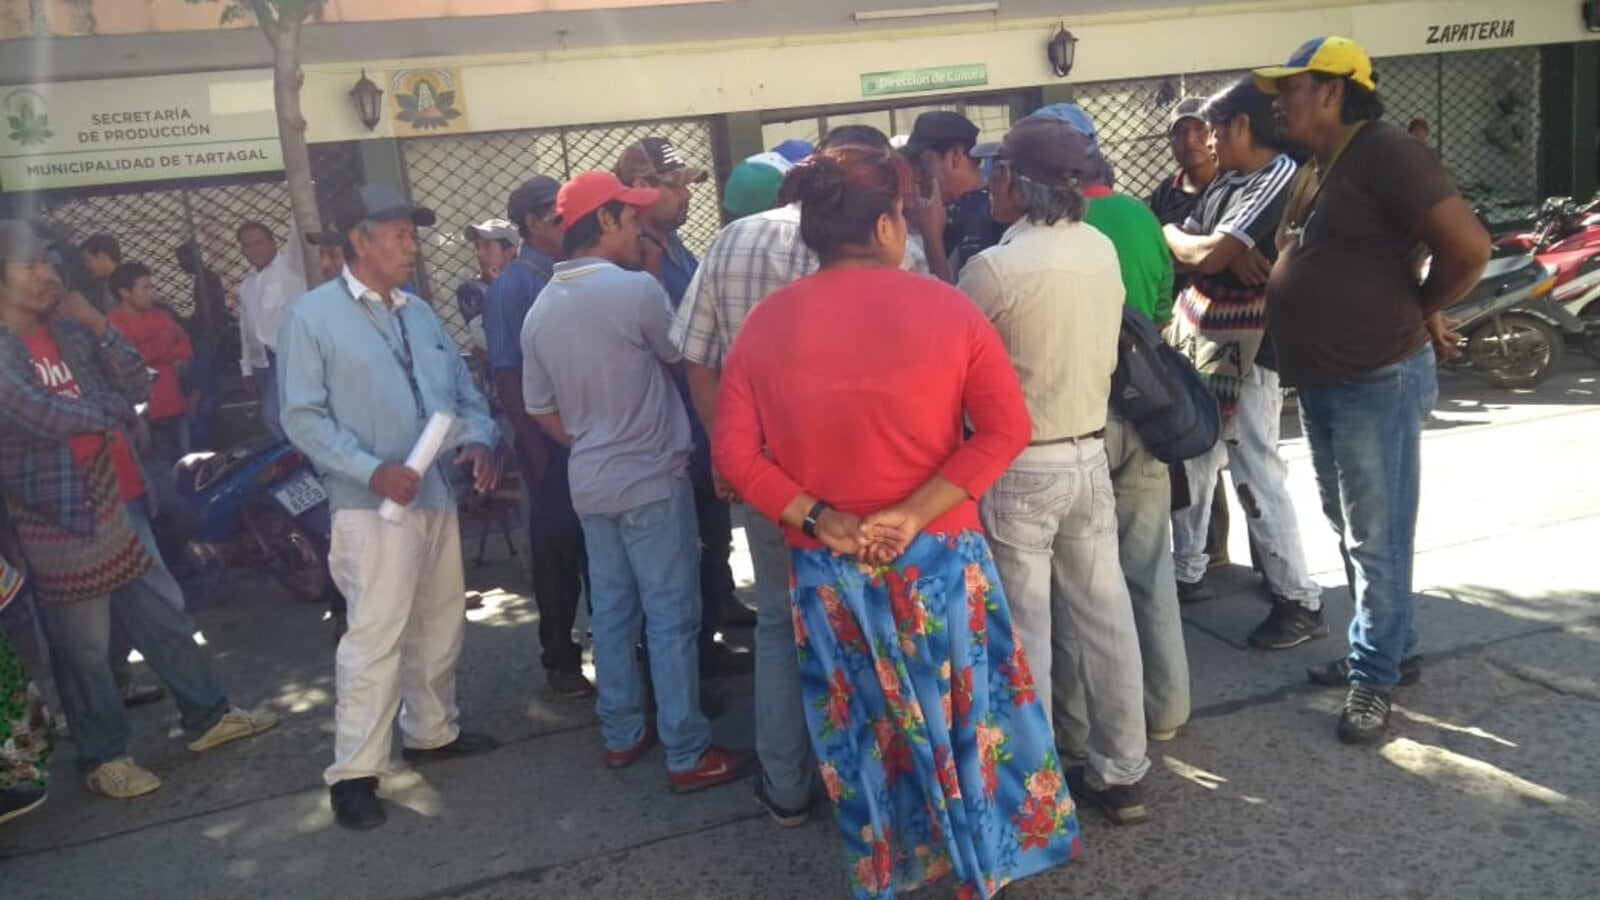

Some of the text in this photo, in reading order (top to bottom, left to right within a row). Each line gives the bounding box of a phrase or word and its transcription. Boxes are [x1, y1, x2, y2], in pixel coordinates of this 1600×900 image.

[1426, 20, 1515, 44] ZAPATERIA
[931, 73, 946, 83] de
[91, 107, 191, 126] SECRETARÍA
[77, 123, 210, 143] DE PRODUCCIÓN
[26, 149, 268, 176] MUNICIPALIDAD DE TARTAGAL
